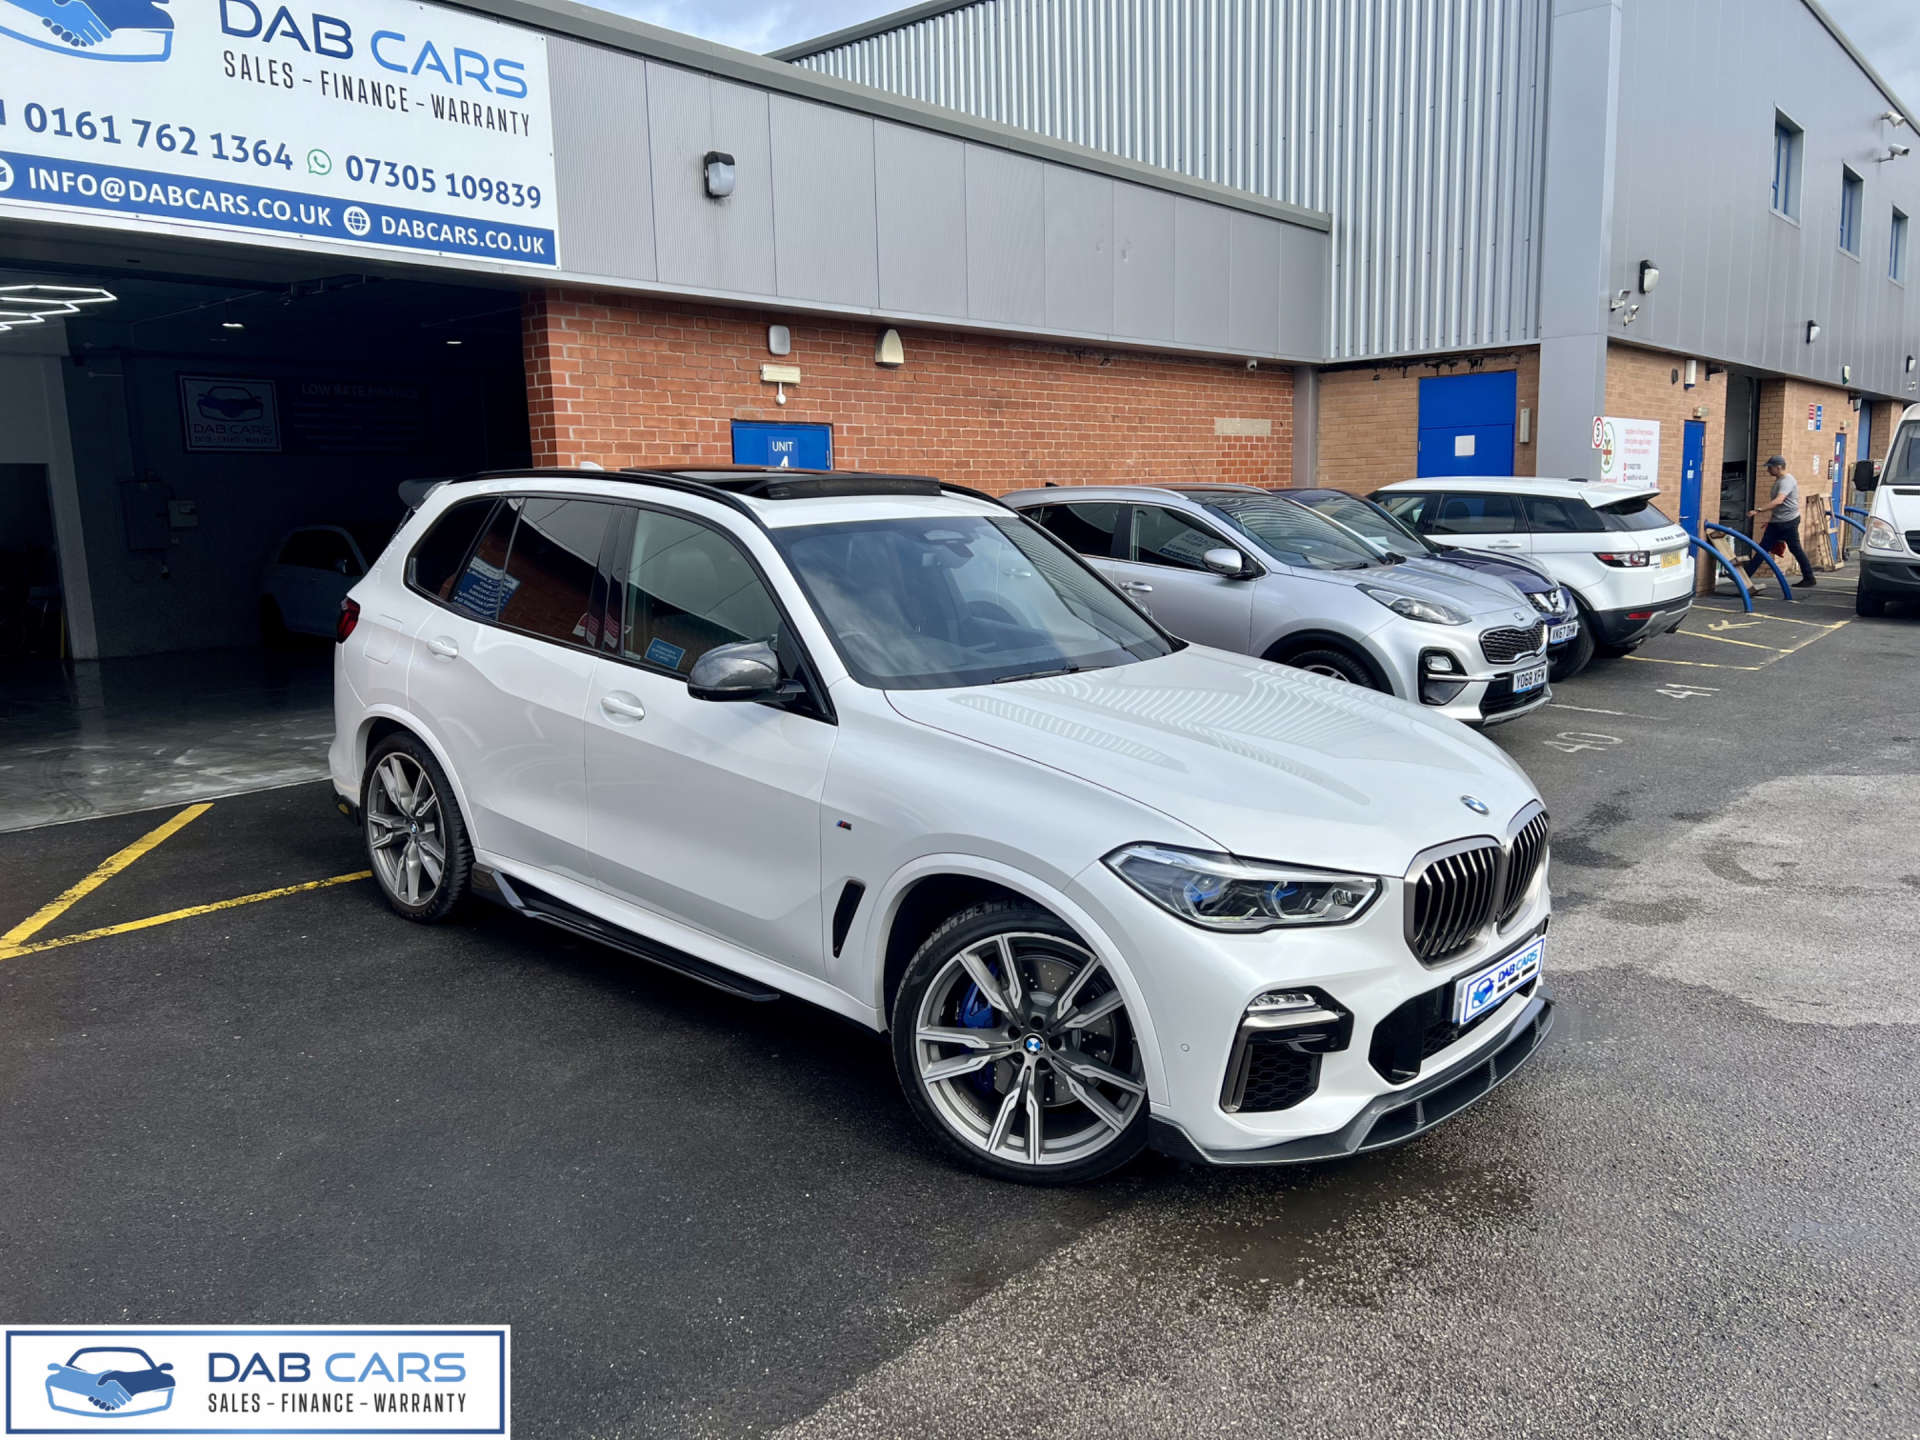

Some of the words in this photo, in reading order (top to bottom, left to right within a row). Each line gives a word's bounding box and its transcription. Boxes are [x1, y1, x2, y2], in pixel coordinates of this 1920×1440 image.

[219, 0, 354, 60] DAB
[370, 30, 528, 99] CARS
[223, 50, 294, 90] SALES
[320, 70, 409, 112] FINANCE
[431, 93, 530, 137] WARRANTY
[23, 102, 122, 145] 0161
[131, 118, 198, 156] 762
[209, 132, 294, 171] 1364
[28, 167, 333, 227] INFO@DABCARS.CO.UK
[345, 155, 437, 193] 07305
[445, 173, 542, 209] 109839
[380, 215, 545, 255] DABCARS.CO.UK
[194, 424, 225, 434] DAB
[771, 441, 794, 452] UNIT
[1543, 731, 1623, 752] 40
[1498, 963, 1515, 982] DAB
[1516, 949, 1538, 970] CARS
